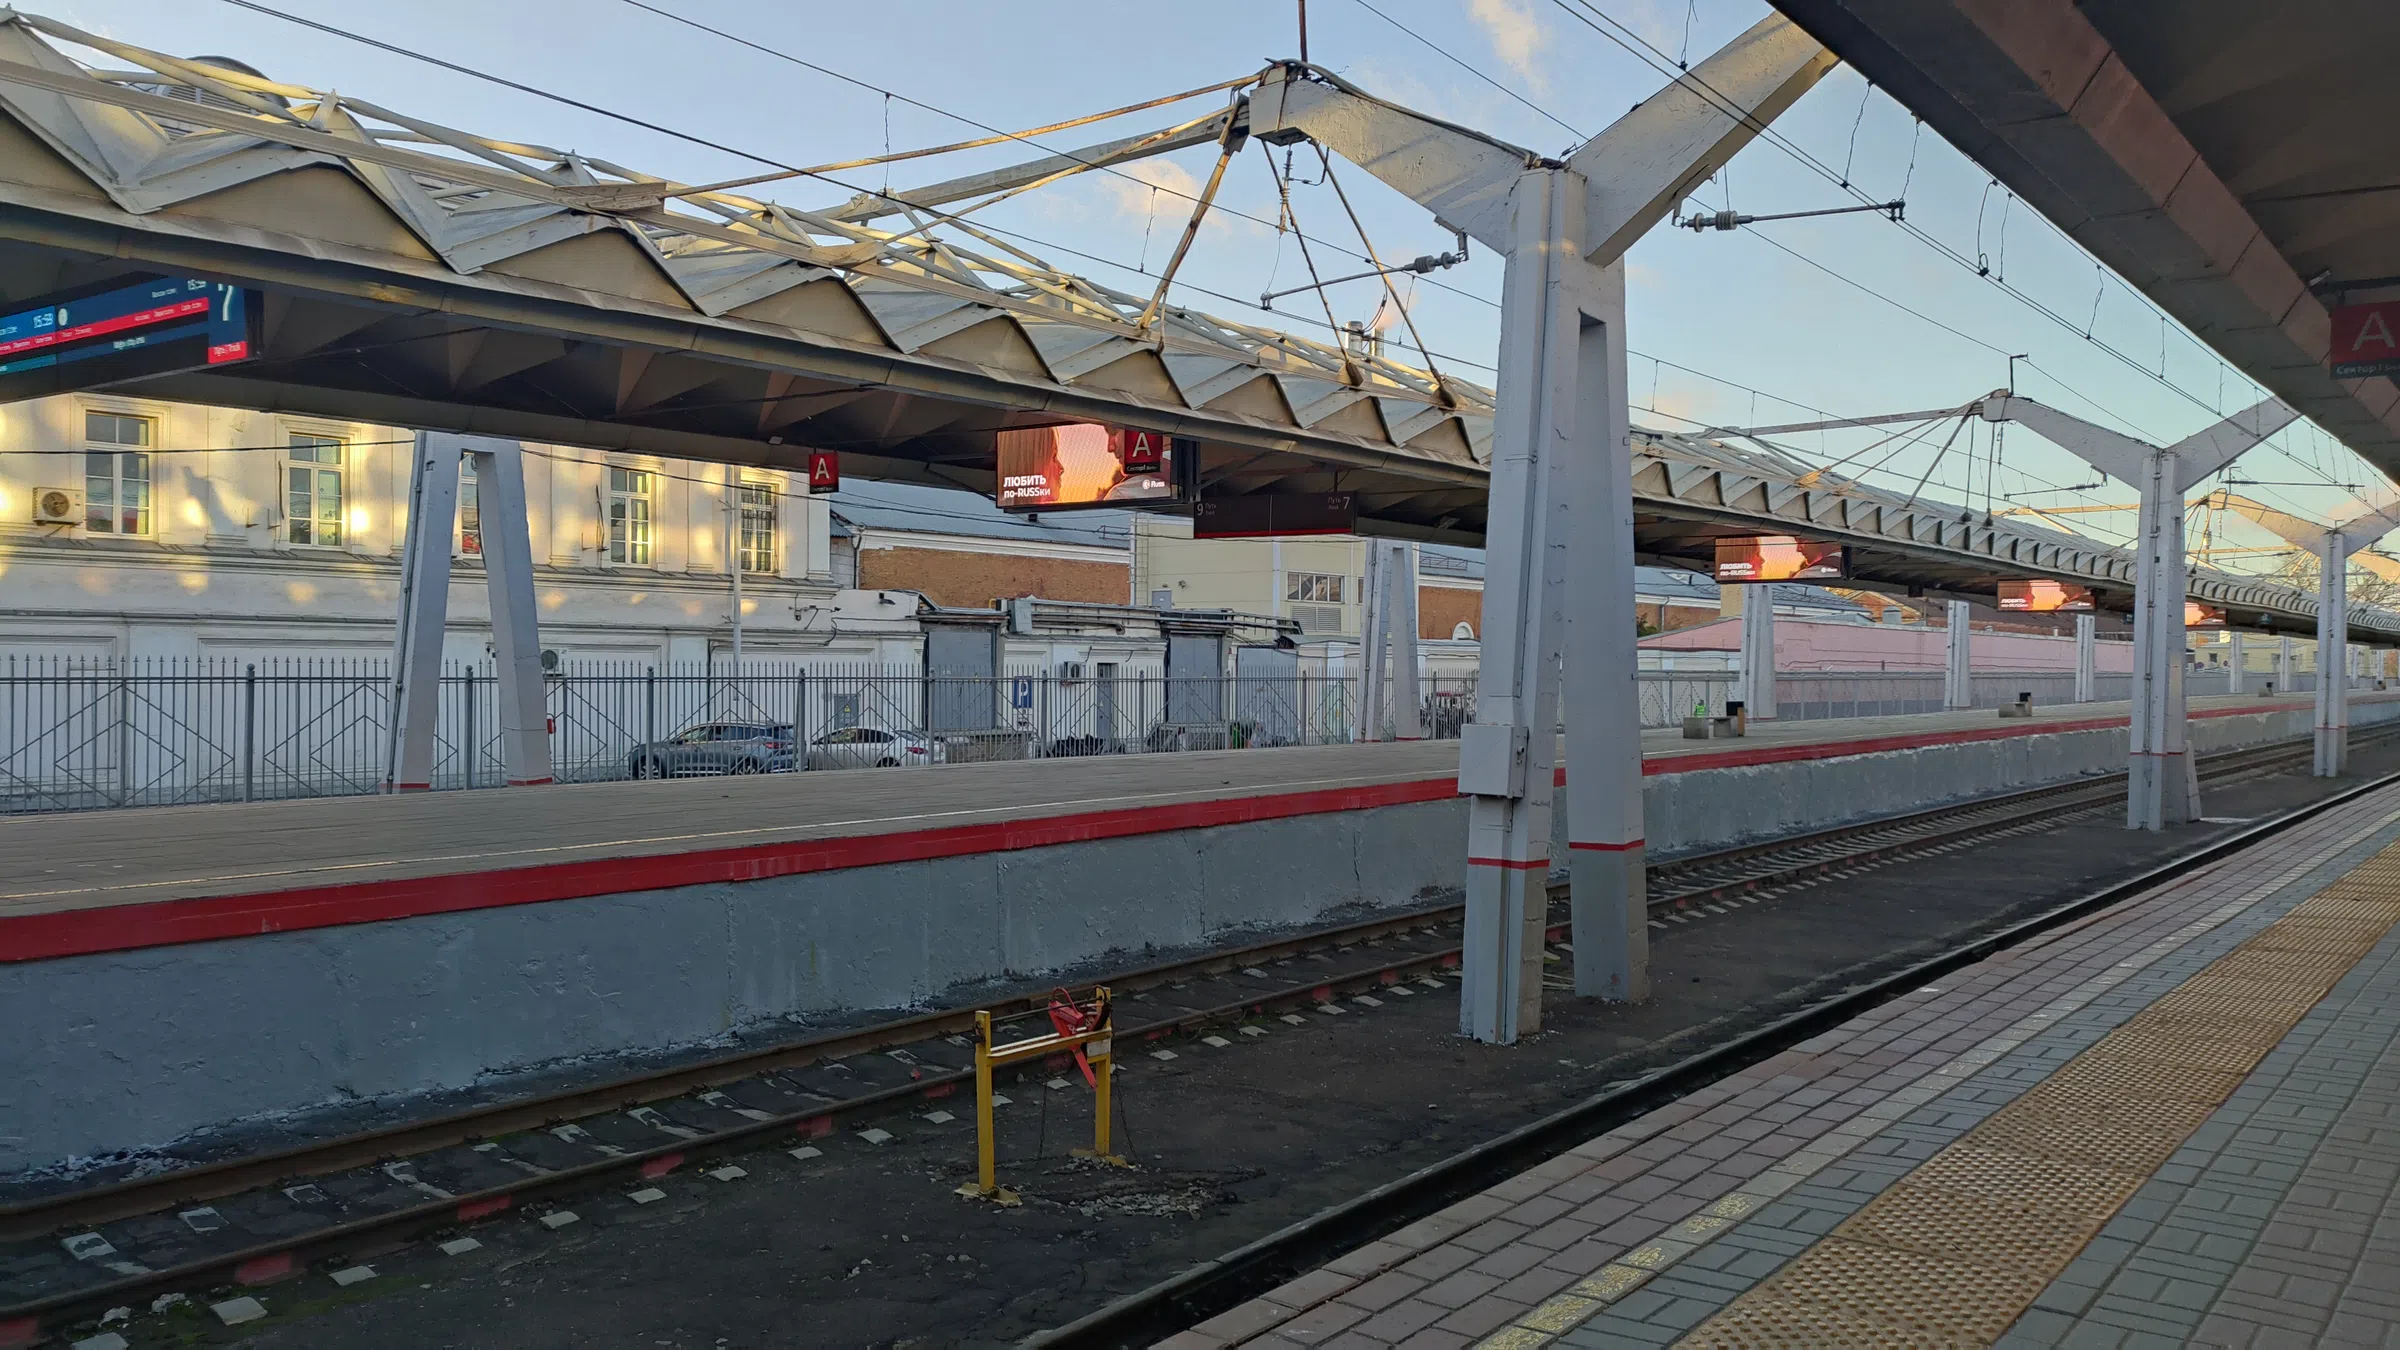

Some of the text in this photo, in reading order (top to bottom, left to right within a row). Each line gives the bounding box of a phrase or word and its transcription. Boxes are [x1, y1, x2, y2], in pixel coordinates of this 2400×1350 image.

[217, 283, 234, 321] 7
[1003, 475, 1047, 487] ЛЮБИТЬ
[1004, 487, 1051, 498] по-RUSSки
[1197, 503, 1204, 516] 9
[1343, 496, 1350, 510] 7
